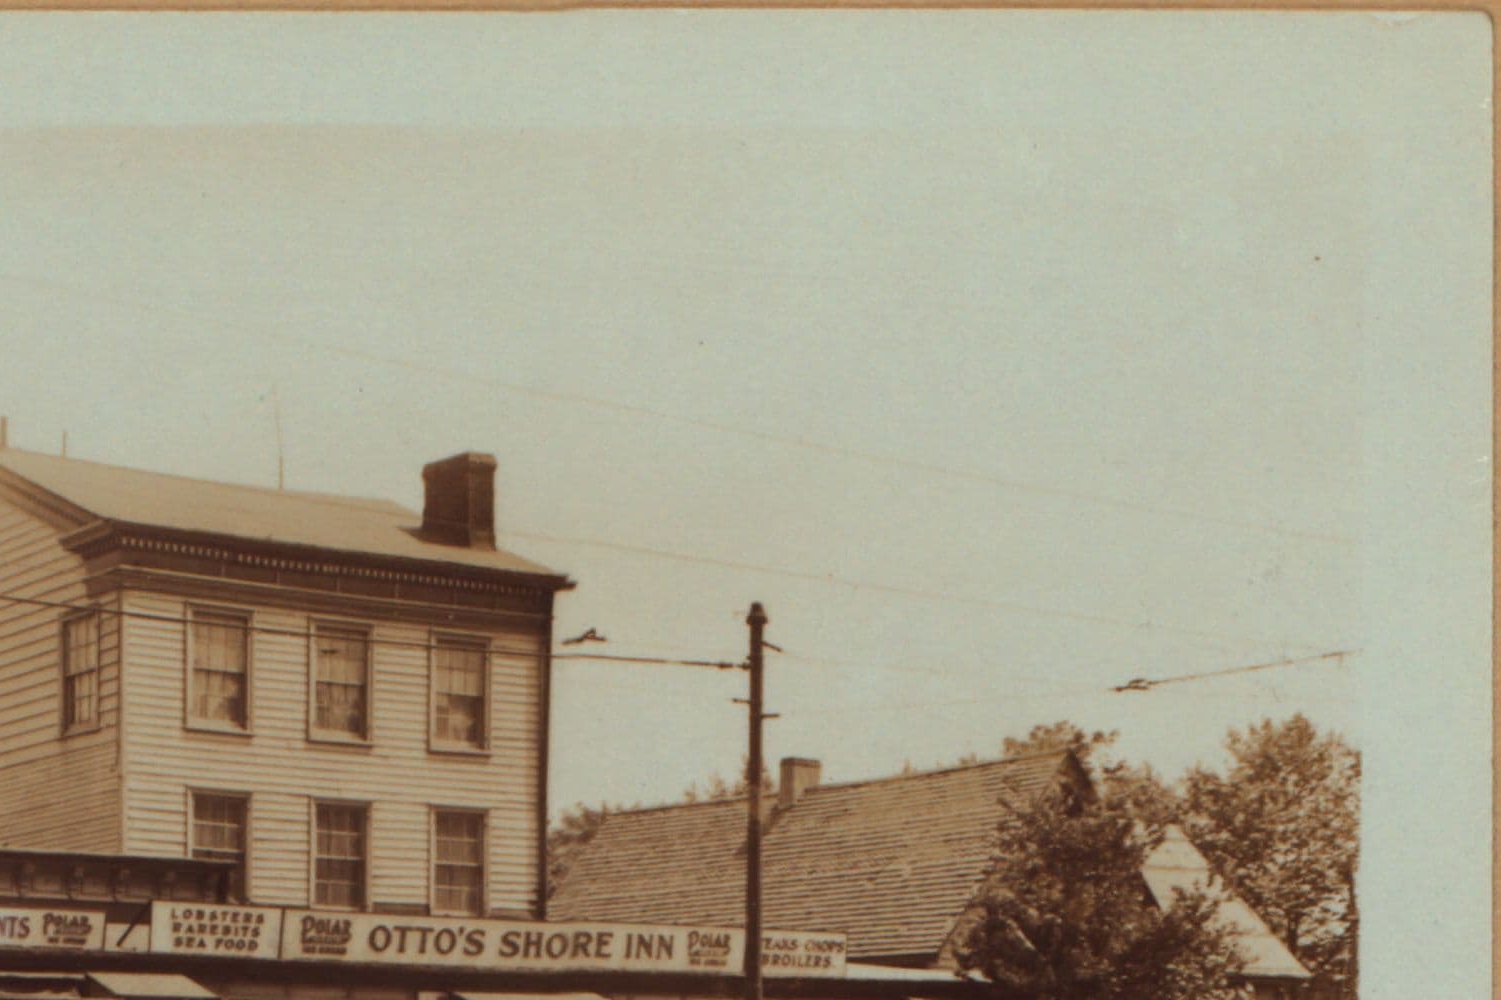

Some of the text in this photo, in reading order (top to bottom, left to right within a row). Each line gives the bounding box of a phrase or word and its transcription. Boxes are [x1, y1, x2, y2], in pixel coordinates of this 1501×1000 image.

[170, 908, 265, 924] LOBSTERS
[171, 922, 260, 938] RAREBITS
[173, 936, 259, 951] SEA FOOD
[368, 924, 675, 960] OTTO'S SHORE INN
[759, 952, 831, 969] BROILERS
